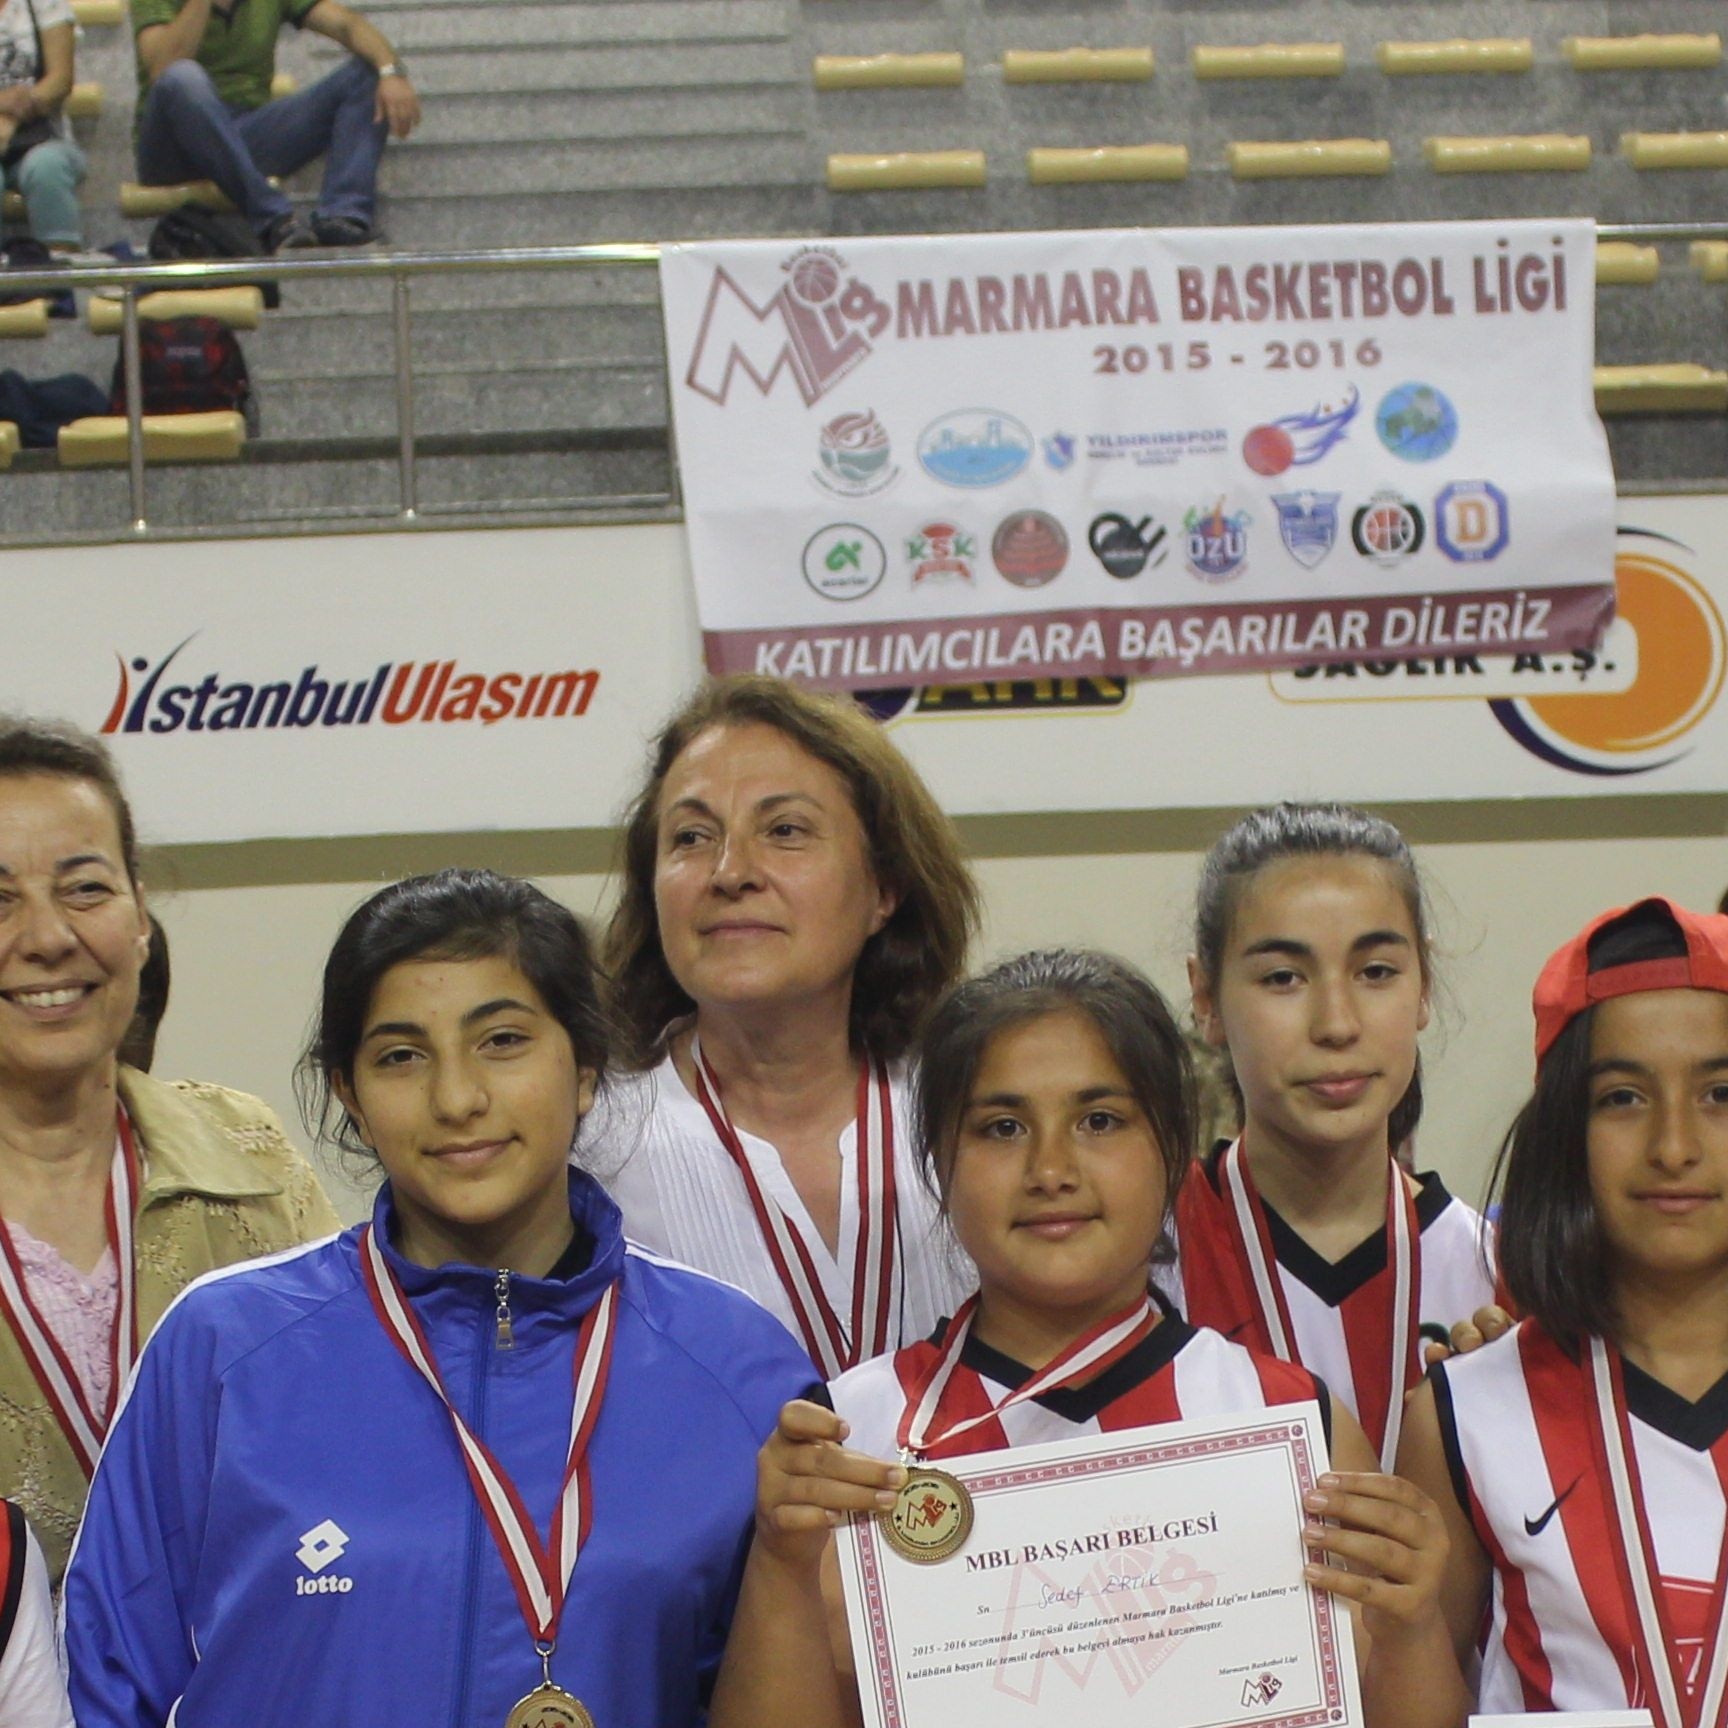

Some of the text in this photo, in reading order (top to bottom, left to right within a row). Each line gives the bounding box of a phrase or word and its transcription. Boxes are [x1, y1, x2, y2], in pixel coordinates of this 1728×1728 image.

[896, 235, 1568, 339] MARMARA BASKETBOL LİGİ
[1093, 341, 1212, 376] 2015
[1264, 338, 1383, 371] 2016
[755, 621, 1106, 679] KATILIMCILARA
[1118, 609, 1370, 668] BAŞARILAR
[1382, 591, 1553, 648] DİLERİZ
[964, 1509, 1219, 1574] MBL BAŞARI BELGESİ
[295, 1572, 354, 1597] lotto
[911, 1644, 935, 1658] 2015
[943, 1640, 967, 1653] 2016
[968, 1632, 1019, 1648] sezonunda
[1066, 1613, 1121, 1632] düzenlenen
[1121, 1606, 1167, 1622] Marmara
[1168, 1598, 1214, 1616] Basketbol
[976, 1603, 991, 1615] Sn
[985, 1656, 998, 1668] ile
[999, 1651, 1028, 1666] temsil
[1029, 1646, 1061, 1661] ederek
[1062, 1644, 1075, 1655] bu
[1111, 1632, 1146, 1648] almaya
[1147, 1629, 1166, 1641] hak
[1218, 1663, 1250, 1677] Marmara
[1250, 1657, 1284, 1670] Basketbol
